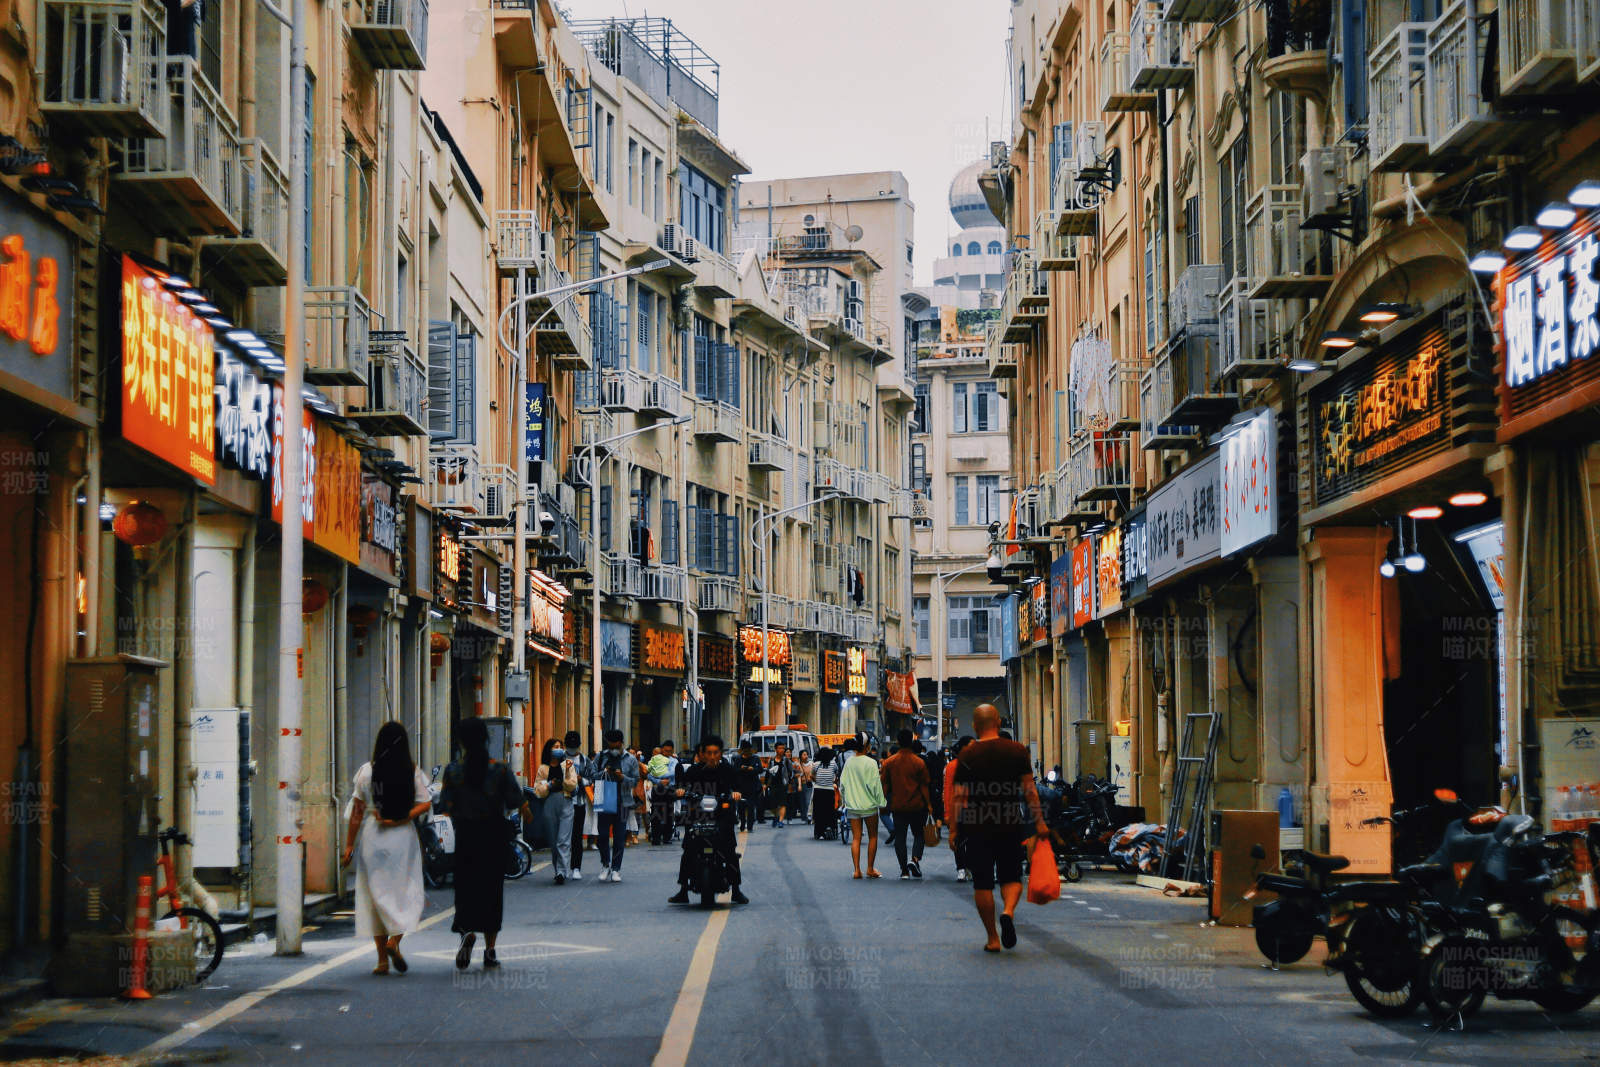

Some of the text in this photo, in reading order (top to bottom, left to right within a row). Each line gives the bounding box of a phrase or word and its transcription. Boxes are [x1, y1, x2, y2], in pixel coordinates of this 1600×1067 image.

[124, 273, 213, 452] 珍珠自产自销
[1505, 233, 1600, 388] 烟酒茶
